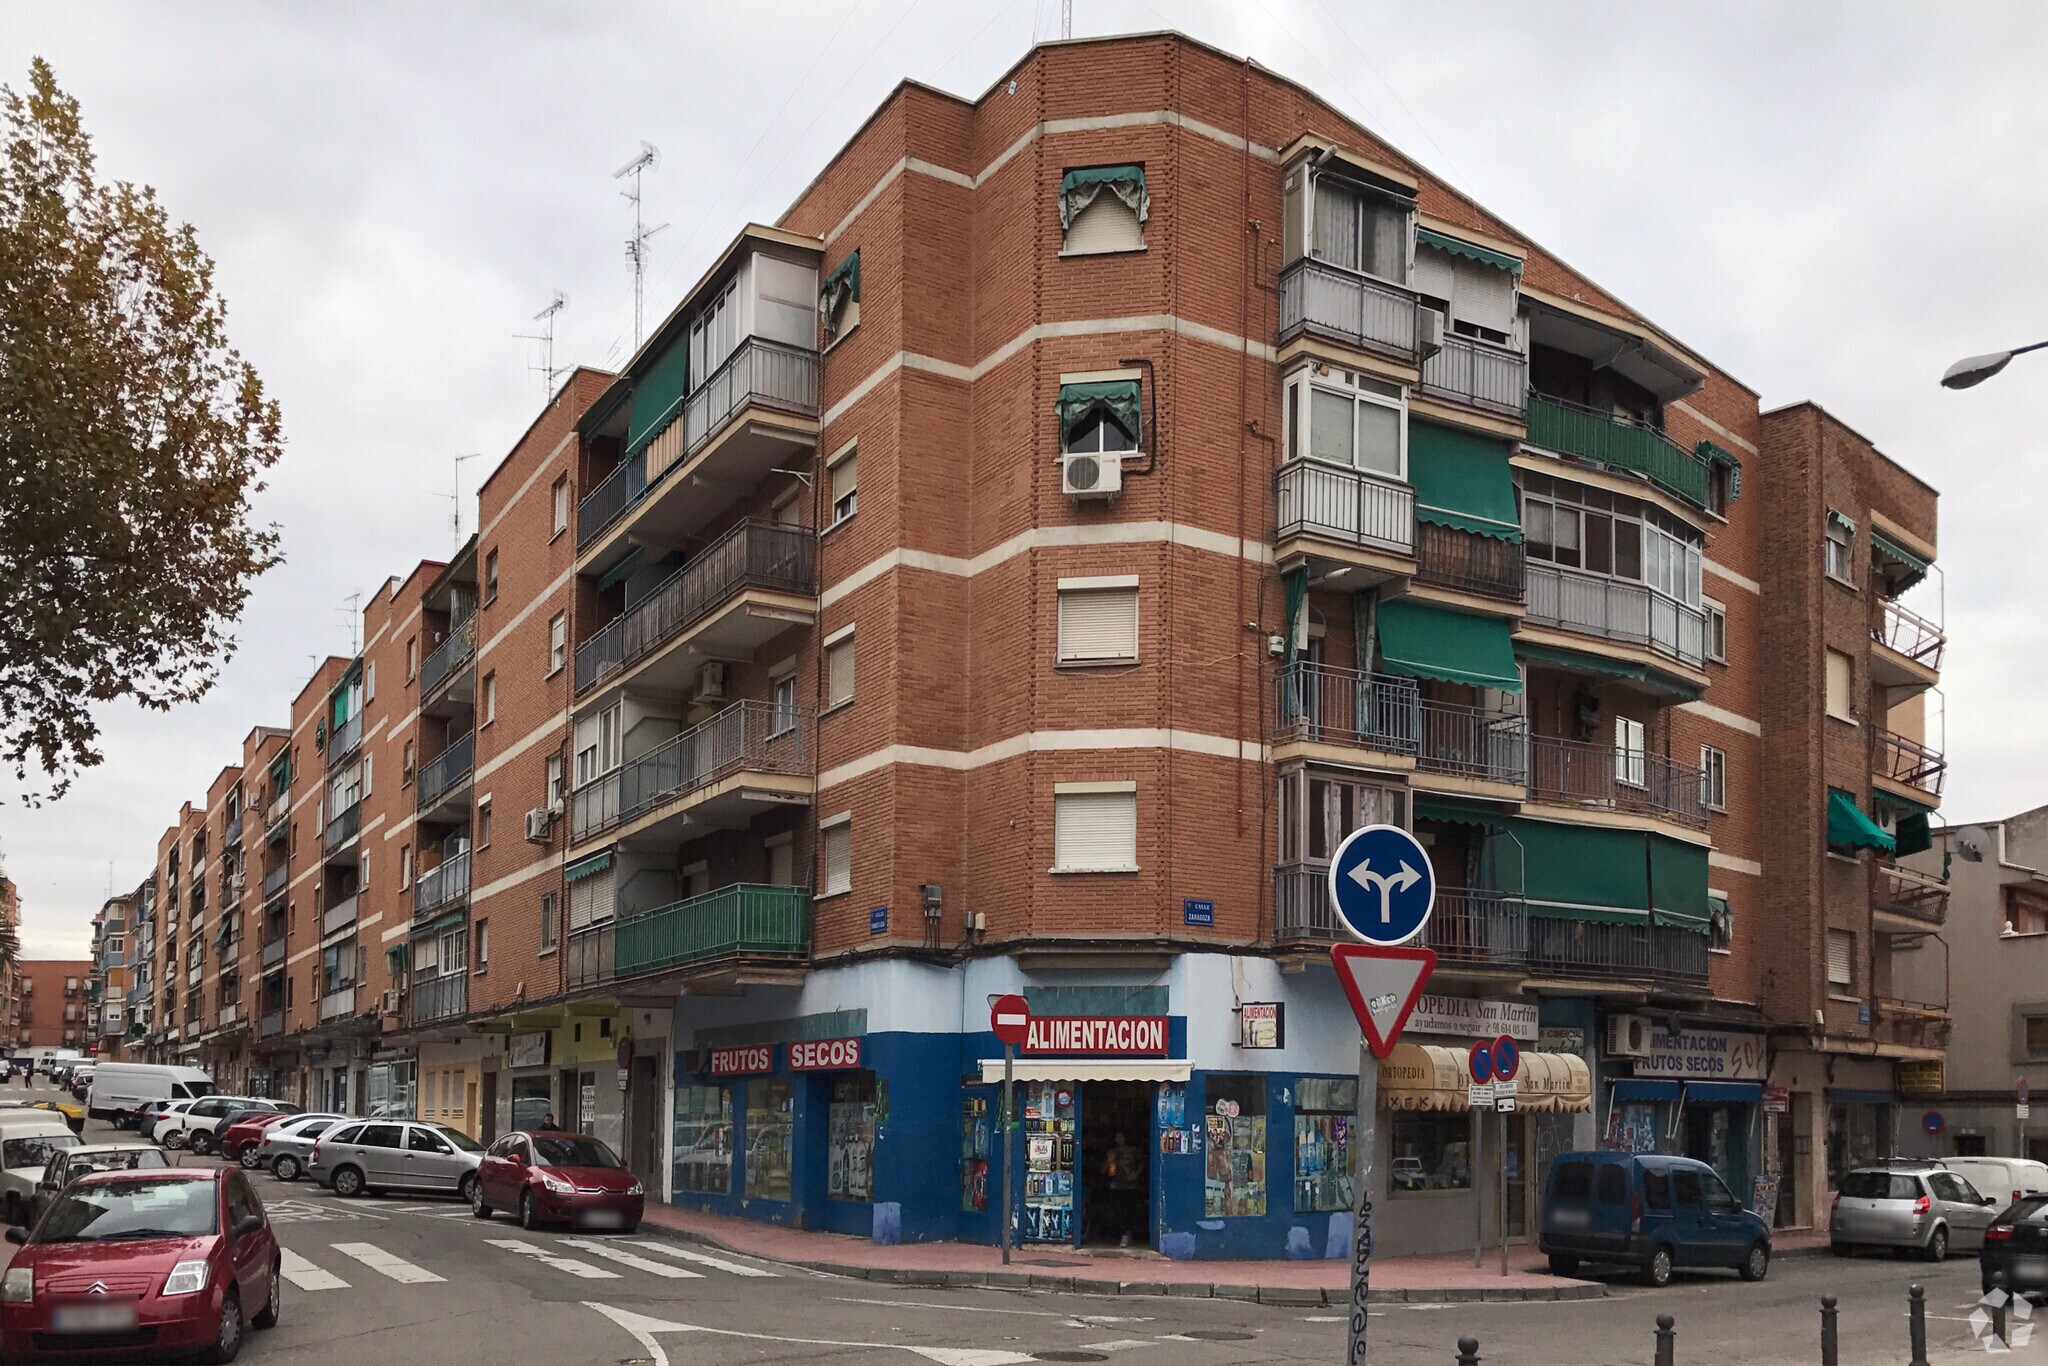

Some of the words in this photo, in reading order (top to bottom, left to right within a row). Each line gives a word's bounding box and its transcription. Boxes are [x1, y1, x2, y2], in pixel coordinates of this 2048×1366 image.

[1188, 913, 1211, 922] ZARAGOZA
[1412, 995, 1470, 1018] OPEDIA
[1475, 1001, 1497, 1020] San
[1500, 1003, 1537, 1023] Martín
[1026, 1020, 1163, 1050] ALIMENTACION
[1415, 1017, 1452, 1032] ayudamos
[1460, 1020, 1481, 1036] seguir
[1651, 1033, 1727, 1053] IMENTACION
[711, 1048, 769, 1073] FRUTOS
[791, 1040, 858, 1067] SECOS
[1382, 1066, 1425, 1079] ORTOPEDIA
[1686, 1056, 1724, 1073] SECOS
[1524, 1075, 1539, 1090] San
